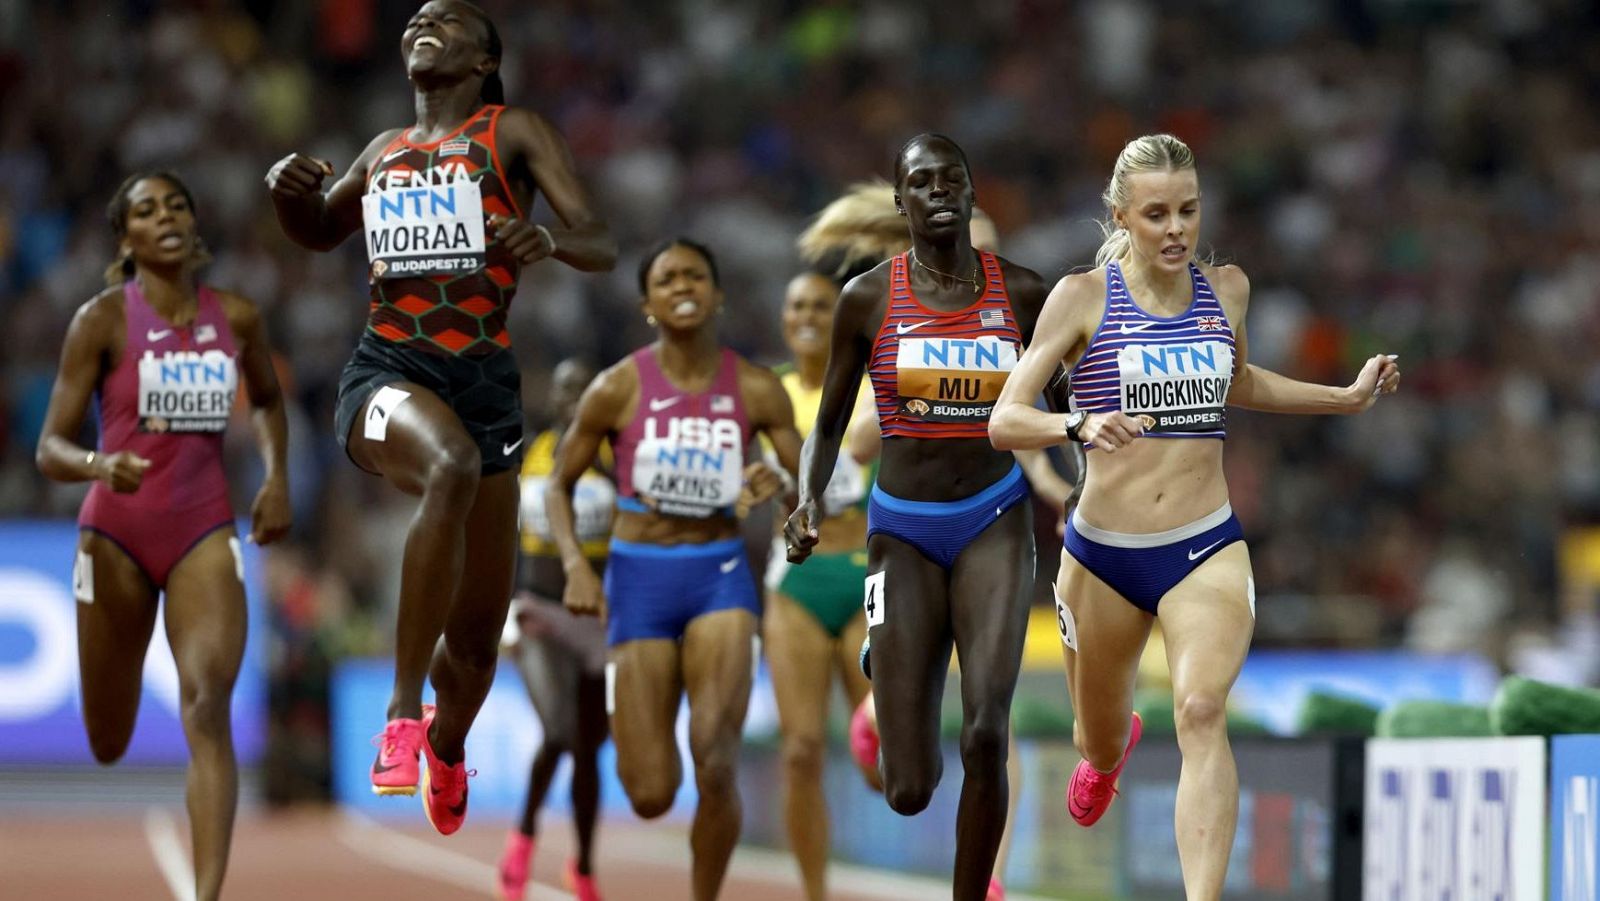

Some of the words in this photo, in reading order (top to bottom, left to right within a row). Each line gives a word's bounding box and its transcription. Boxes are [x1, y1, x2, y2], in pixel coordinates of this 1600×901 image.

[369, 162, 472, 196] KENYA
[380, 187, 456, 221] NTN
[371, 222, 471, 256] MORAA
[391, 259, 460, 272] BUDAPEST
[462, 258, 477, 269] 23
[923, 339, 999, 369] NTN
[1141, 344, 1216, 377] NTN
[161, 362, 226, 384] NTN
[938, 377, 981, 401] MU
[644, 416, 741, 450] USA
[657, 446, 725, 472] NTN
[650, 472, 722, 500] AKINS
[867, 583, 875, 618] 4
